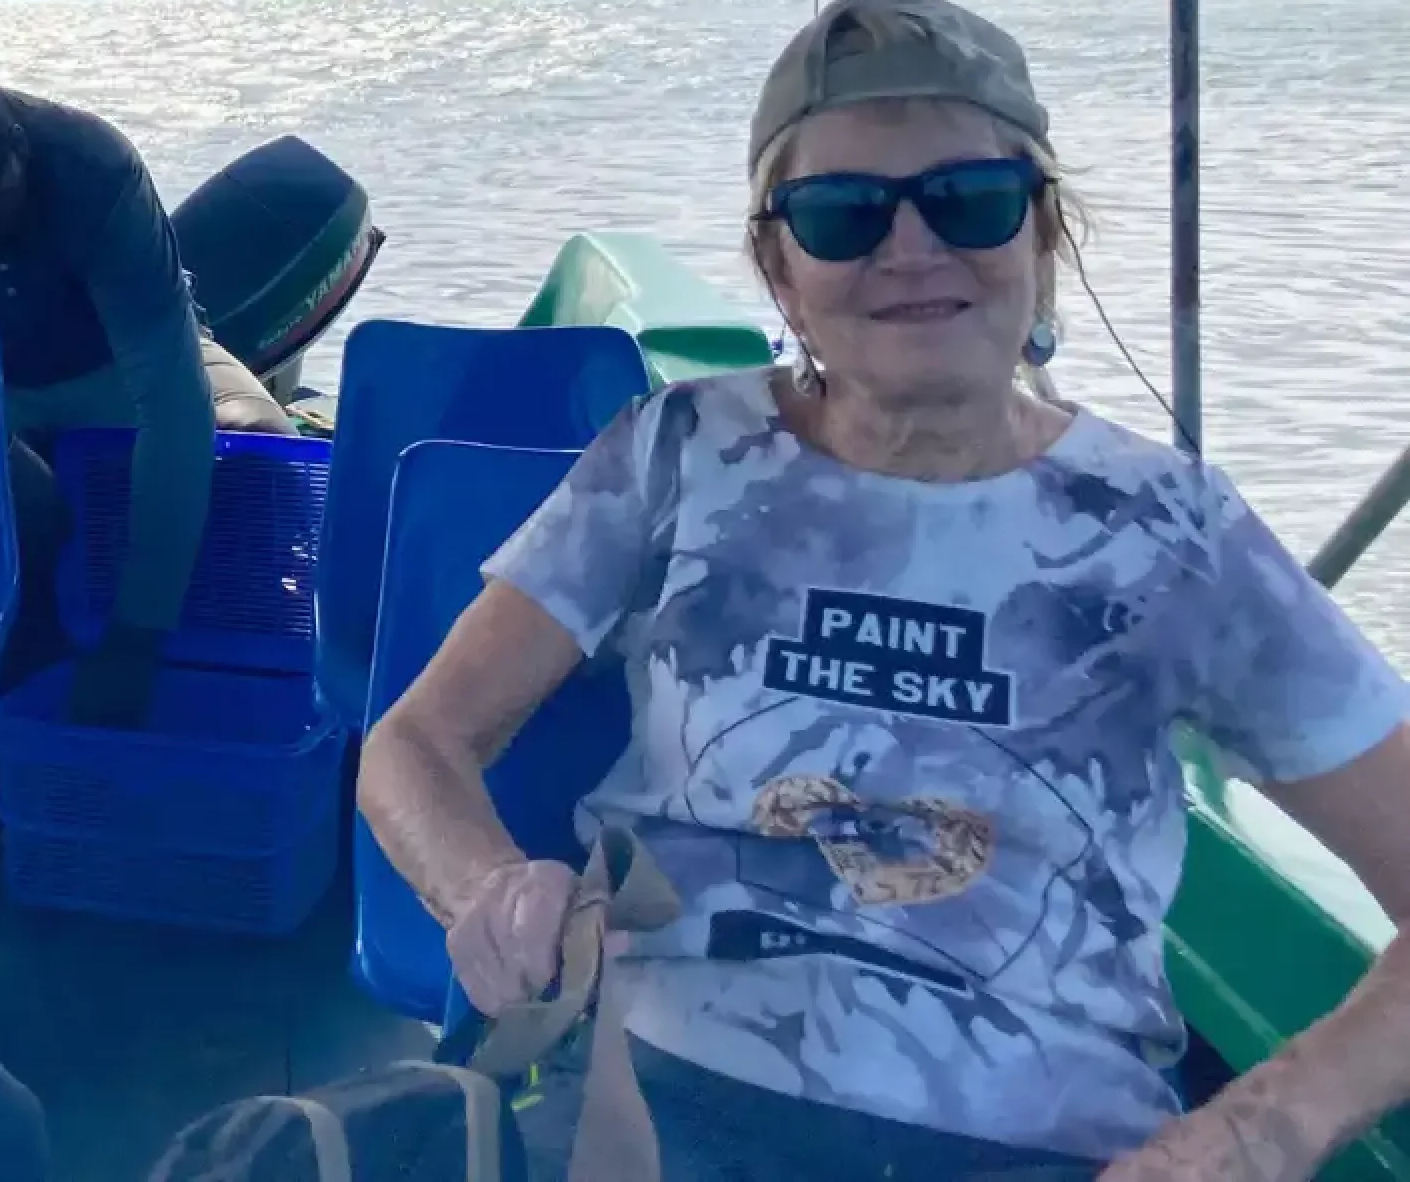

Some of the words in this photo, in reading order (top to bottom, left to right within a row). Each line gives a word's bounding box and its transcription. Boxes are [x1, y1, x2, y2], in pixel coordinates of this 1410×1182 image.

[821, 607, 967, 659] PAINT
[779, 649, 876, 697] THE
[891, 670, 993, 714] SKY
